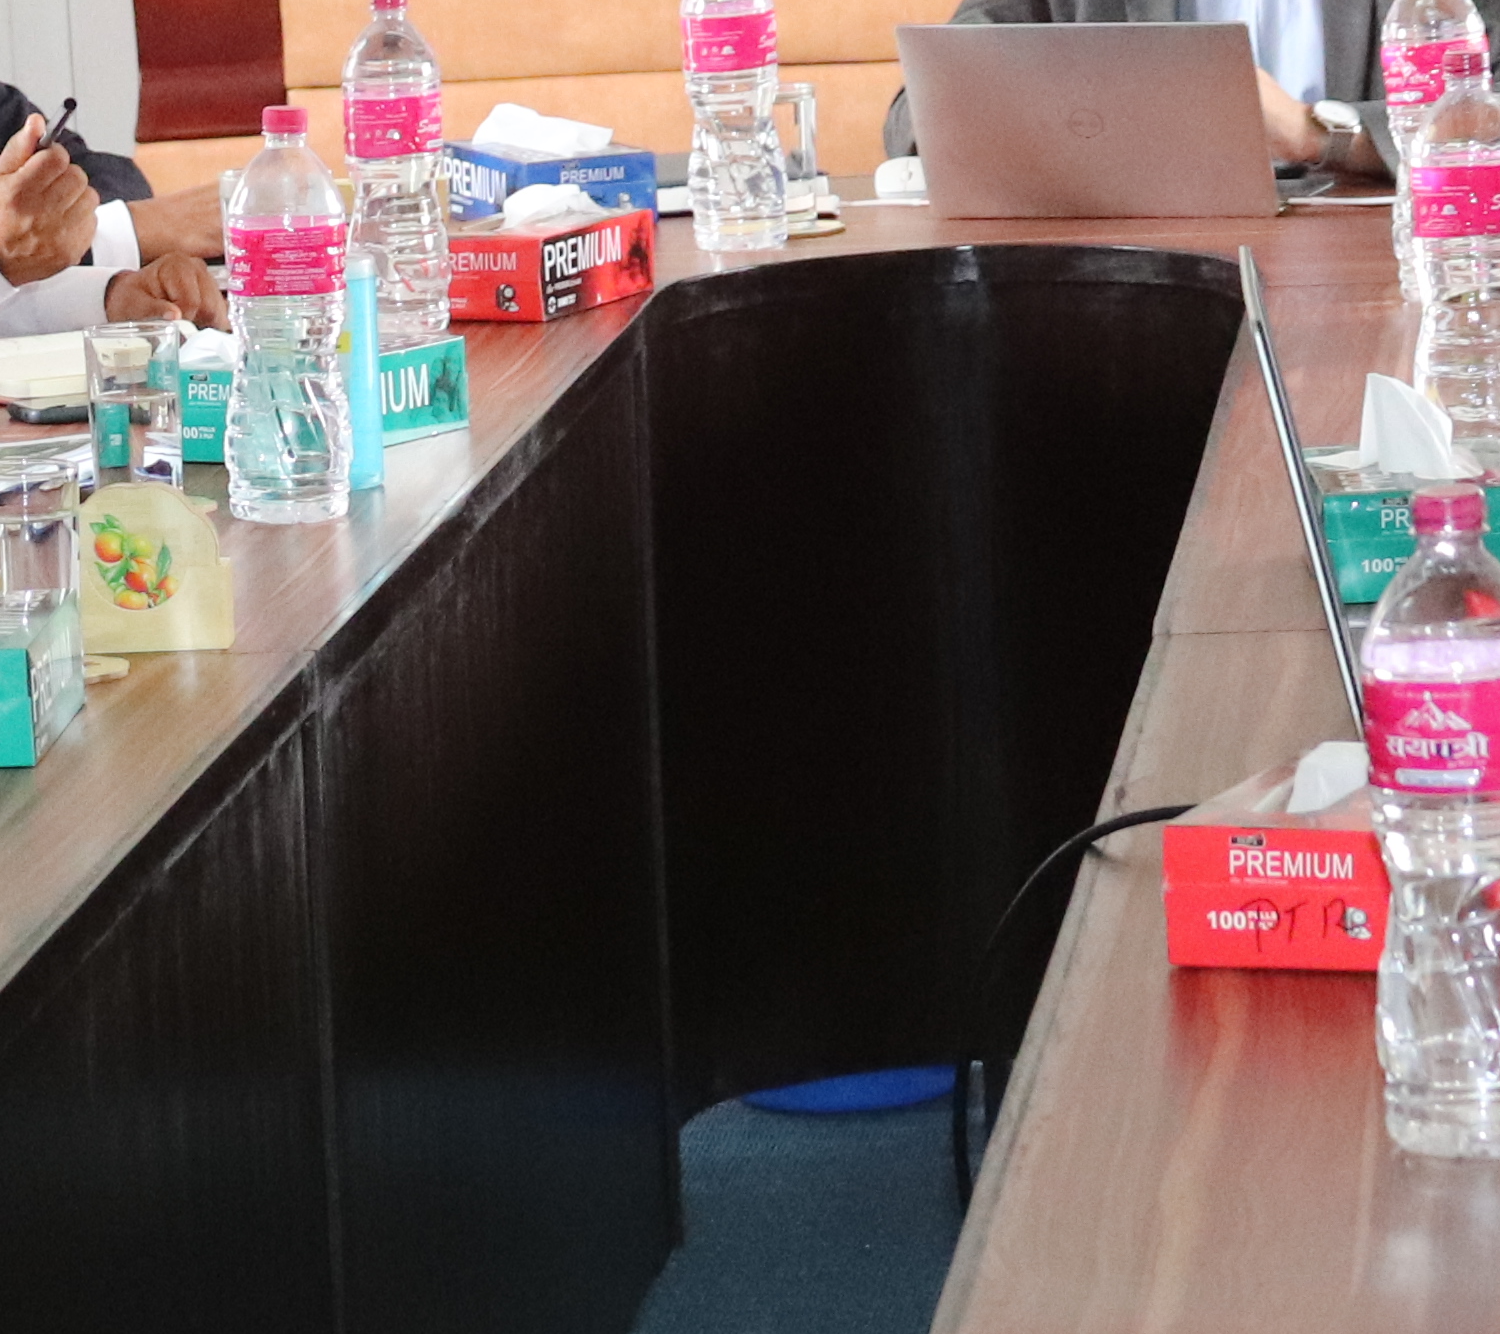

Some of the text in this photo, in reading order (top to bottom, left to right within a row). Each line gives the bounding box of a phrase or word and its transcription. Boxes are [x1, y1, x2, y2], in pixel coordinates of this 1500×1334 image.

[444, 157, 508, 204] PREMIUM
[560, 166, 624, 184] PREMIUM
[449, 252, 517, 271] REMIUM
[543, 225, 622, 282] PREMIUM
[188, 383, 229, 401] PREM
[182, 426, 198, 439] 00
[1361, 558, 1394, 573] 100
[1229, 849, 1354, 879] PREMIUM
[1206, 910, 1247, 930] 100
